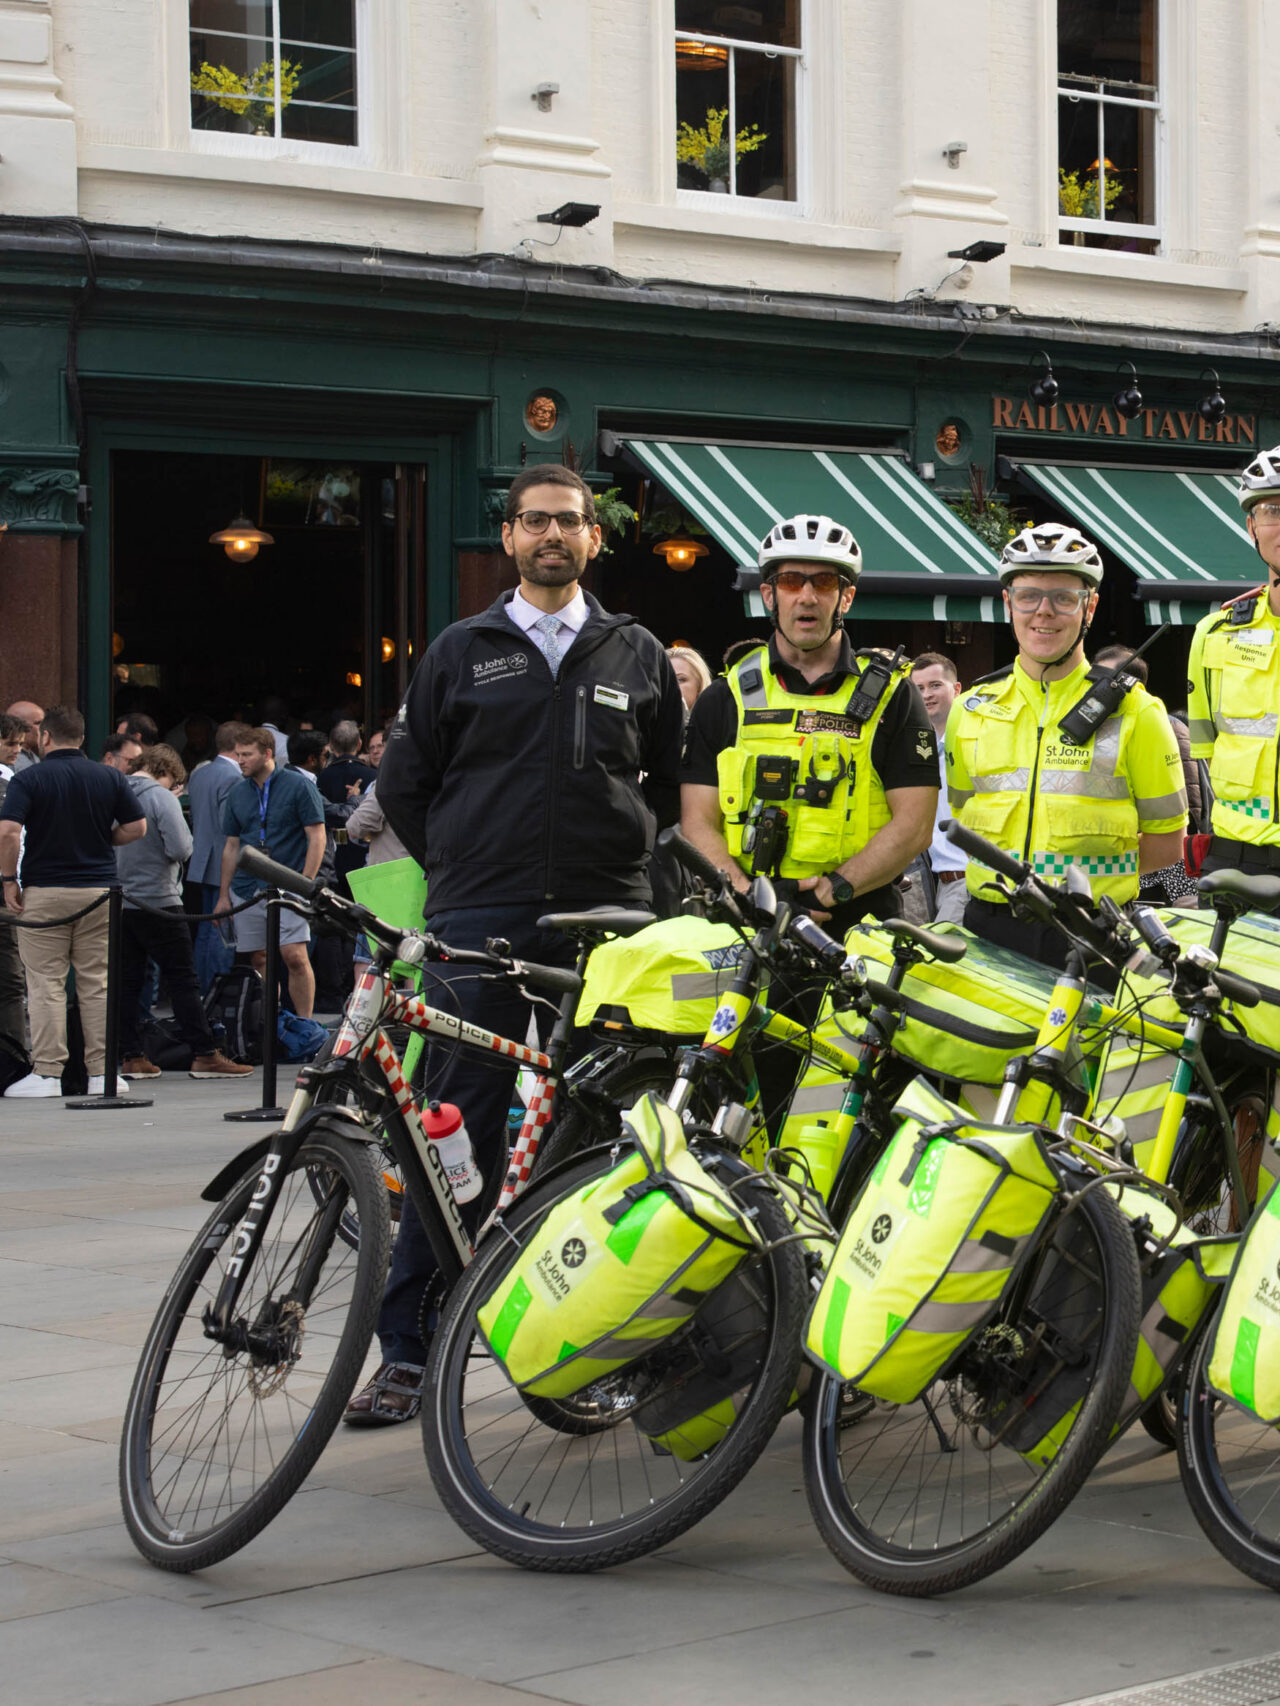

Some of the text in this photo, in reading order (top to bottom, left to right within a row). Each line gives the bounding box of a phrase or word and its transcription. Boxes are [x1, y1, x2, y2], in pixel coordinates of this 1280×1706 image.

[1234, 644, 1267, 657] Response
[1241, 654, 1256, 663] Unit
[473, 656, 507, 673] St John
[474, 665, 509, 678] Ambulance
[819, 719, 858, 732] POLICE
[1046, 745, 1089, 757] St John
[1045, 757, 1089, 766] Ambulance
[417, 1118, 469, 1247] POLICE
[450, 1178, 472, 1190] EAM
[227, 1153, 282, 1279] POLICE
[854, 1238, 882, 1270] St John
[541, 1249, 571, 1295] St John
[849, 1251, 876, 1279] Ambulance
[535, 1260, 562, 1302] Ambulance
[1258, 1277, 1270, 1294] St
